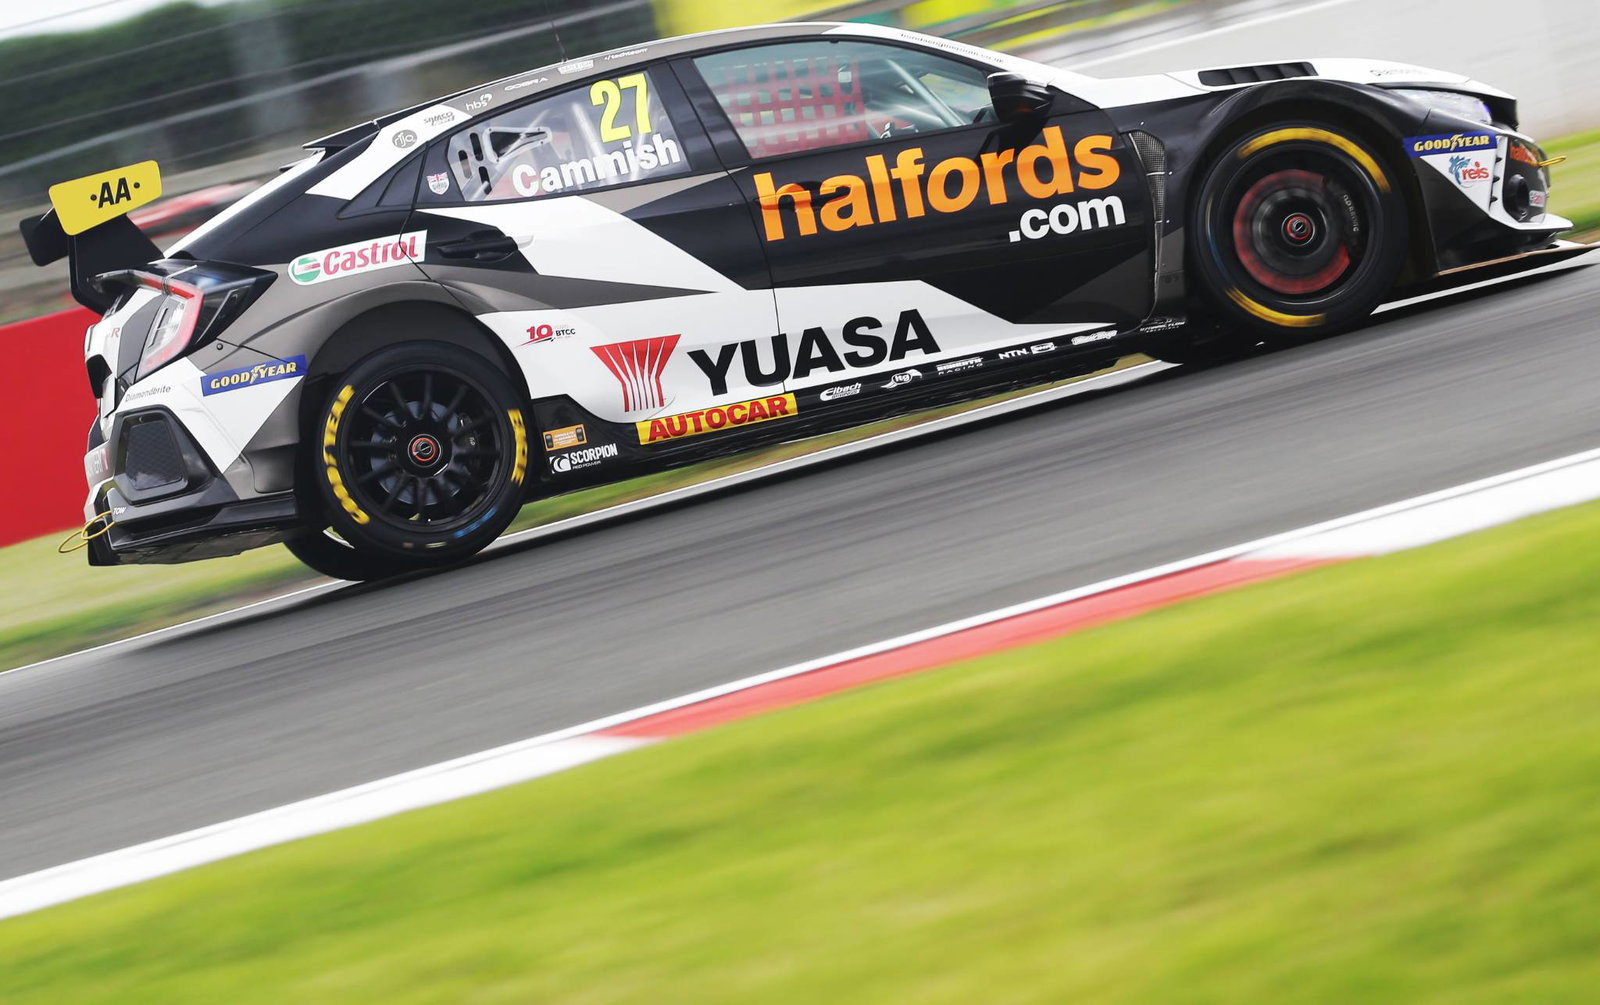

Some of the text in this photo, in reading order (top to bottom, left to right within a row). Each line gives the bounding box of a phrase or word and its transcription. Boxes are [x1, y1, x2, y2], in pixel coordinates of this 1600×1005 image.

[589, 72, 652, 143] 27
[1413, 134, 1490, 152] GOODYEAR
[512, 134, 681, 198] Cammish
[1462, 161, 1489, 180] reis
[753, 126, 1121, 242] halfords
[1009, 195, 1126, 243] .com
[323, 236, 419, 276] Castrol
[526, 324, 576, 340] 10 BTCC
[687, 309, 941, 396] YUASA
[999, 348, 1028, 360] NTN
[210, 362, 297, 390] GOODYEAR
[820, 382, 862, 401] Eibach
[648, 396, 790, 442] AUTOCAR
[570, 442, 618, 465] SCORPION
[113, 506, 127, 515] TOW
